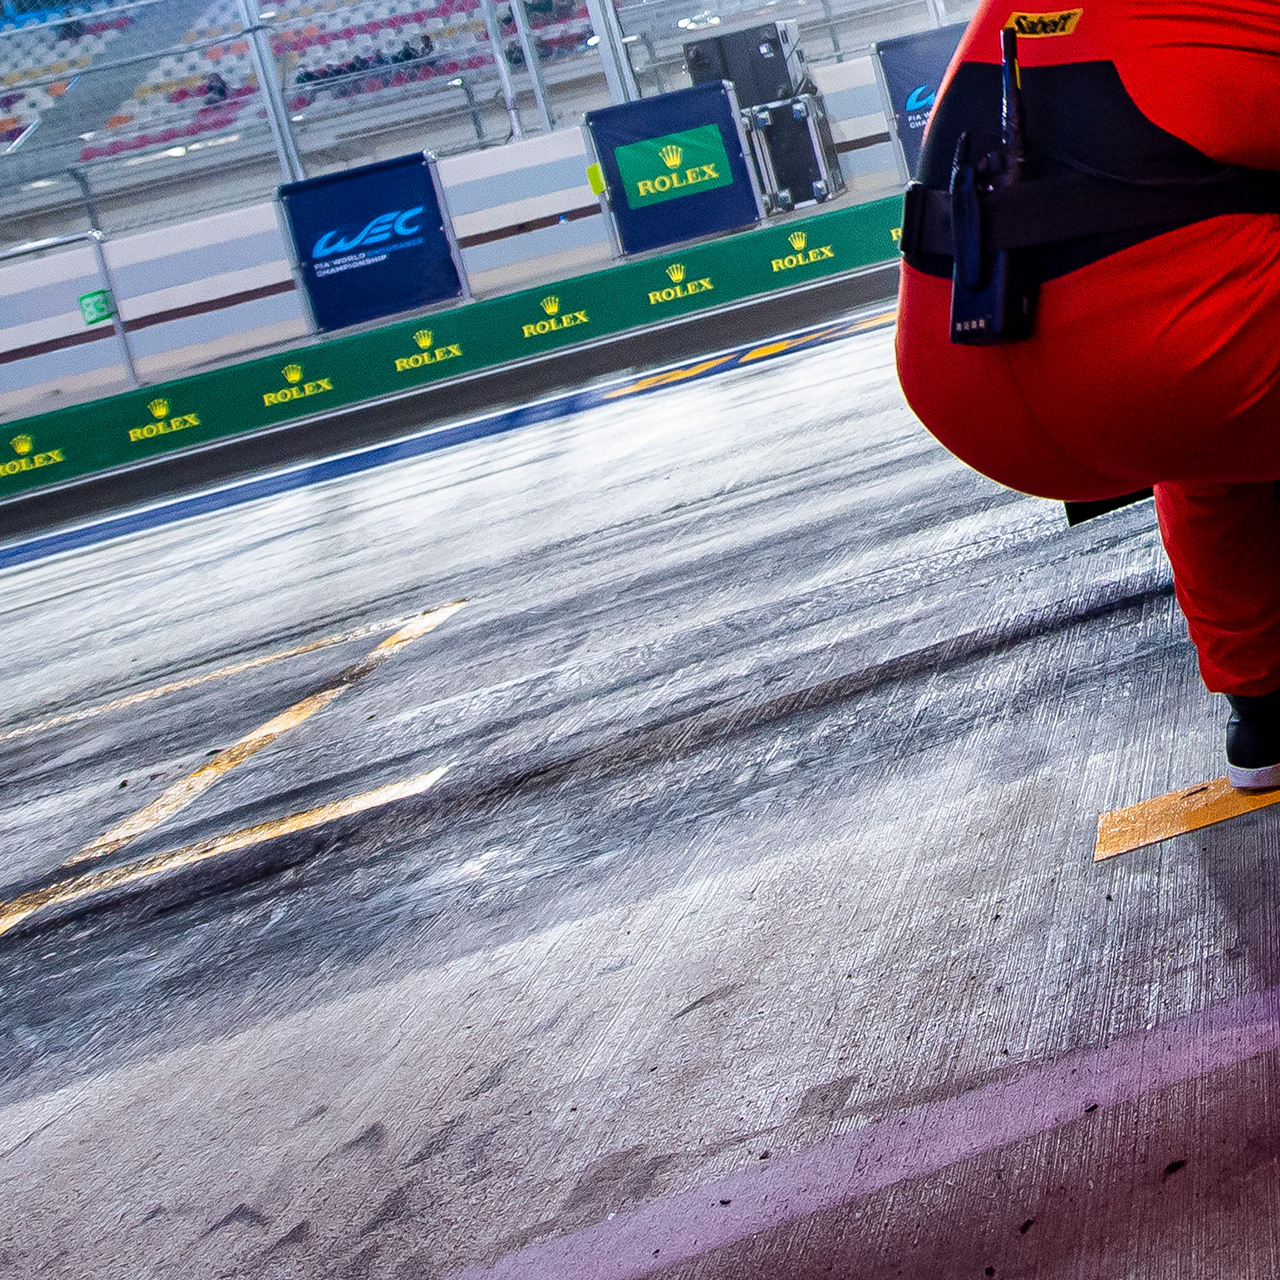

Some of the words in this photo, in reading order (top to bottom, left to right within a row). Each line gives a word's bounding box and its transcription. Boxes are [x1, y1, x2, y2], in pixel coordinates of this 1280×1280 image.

[636, 162, 720, 197] ROLEX
[311, 205, 425, 259] WEC
[128, 413, 200, 442] ROLEX
[262, 377, 334, 407] ROLEX
[394, 343, 463, 372] ROLEX
[521, 309, 590, 339] ROLEX
[648, 276, 715, 306] ROLEX
[770, 245, 836, 273] ROLEX
